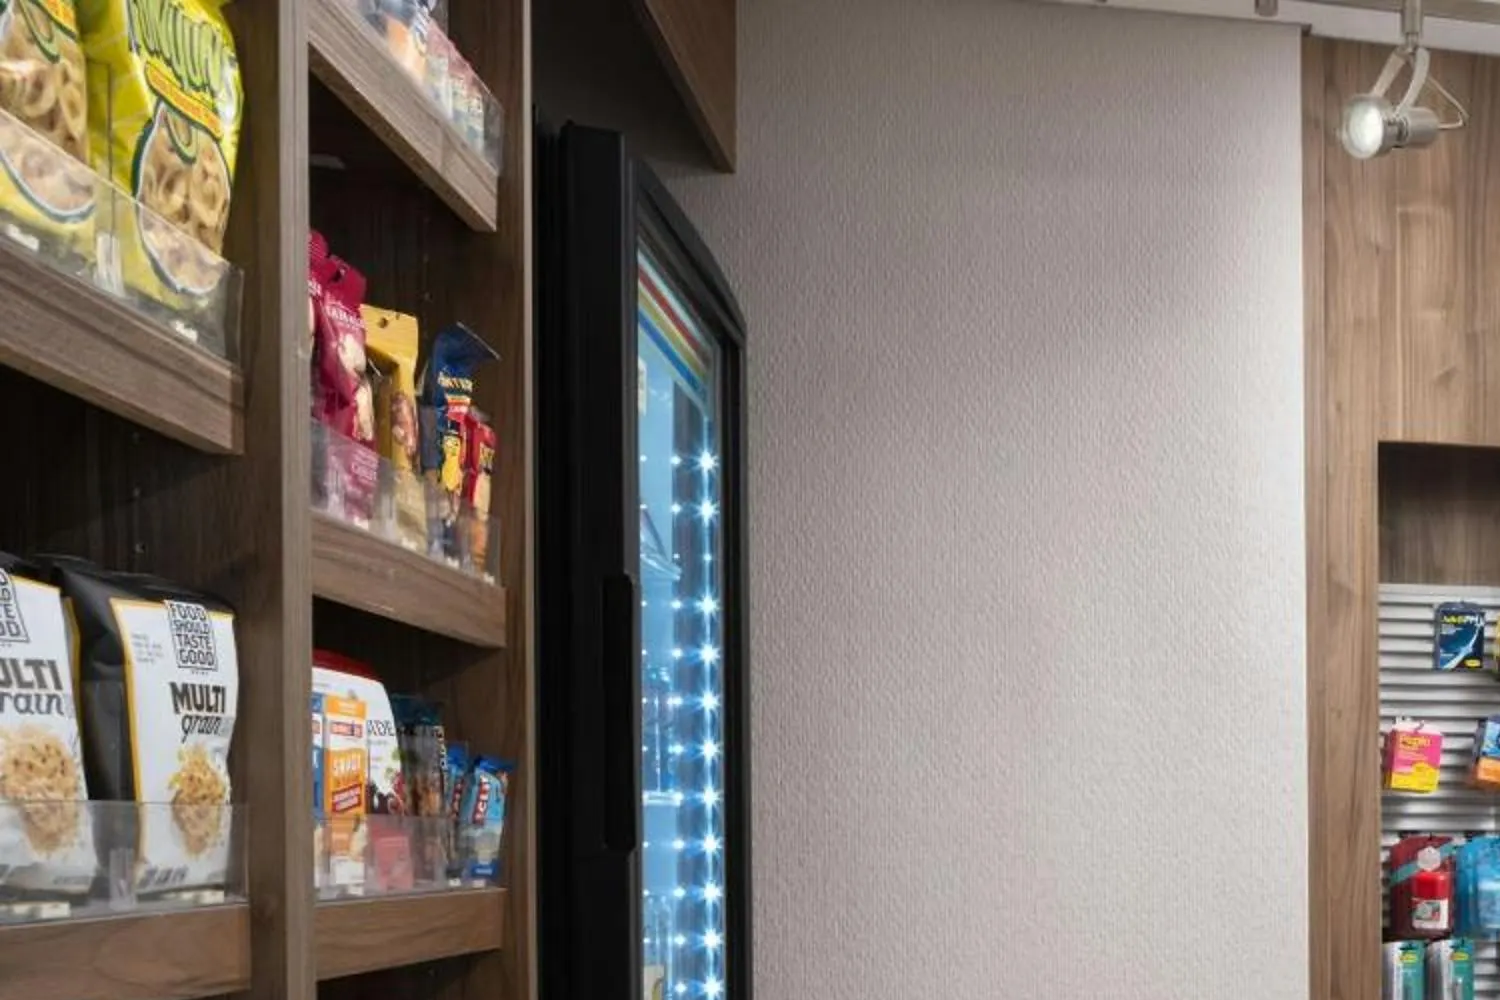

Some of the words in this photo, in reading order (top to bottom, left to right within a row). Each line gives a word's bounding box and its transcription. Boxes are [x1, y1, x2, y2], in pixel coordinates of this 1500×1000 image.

[169, 603, 207, 621] FOOD
[172, 619, 212, 635] SHOULD
[175, 633, 213, 650] TASTE
[179, 649, 215, 666] GOOD
[169, 682, 227, 714] MULTI
[181, 714, 221, 744] grain
